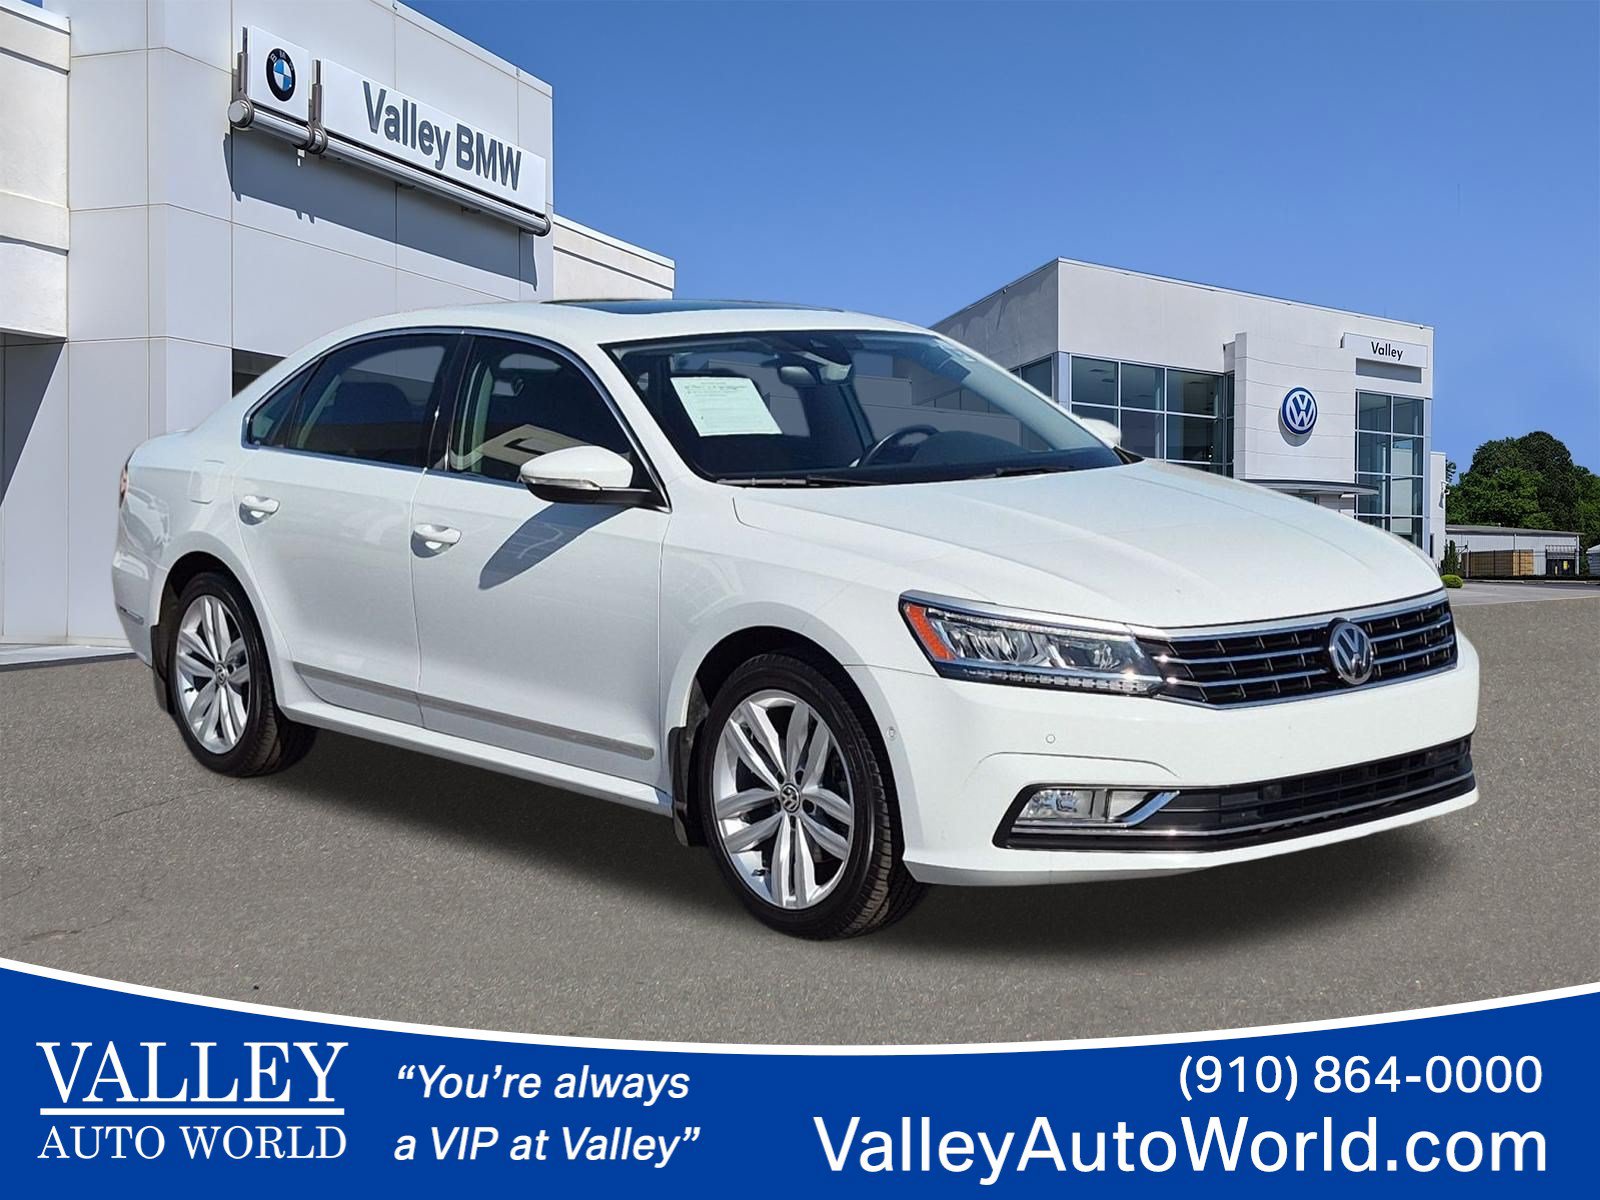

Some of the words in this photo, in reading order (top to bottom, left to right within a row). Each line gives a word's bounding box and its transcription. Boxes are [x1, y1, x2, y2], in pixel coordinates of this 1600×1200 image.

[362, 80, 451, 171] Valley
[456, 123, 522, 191] BMW
[1371, 341, 1403, 361] Valley
